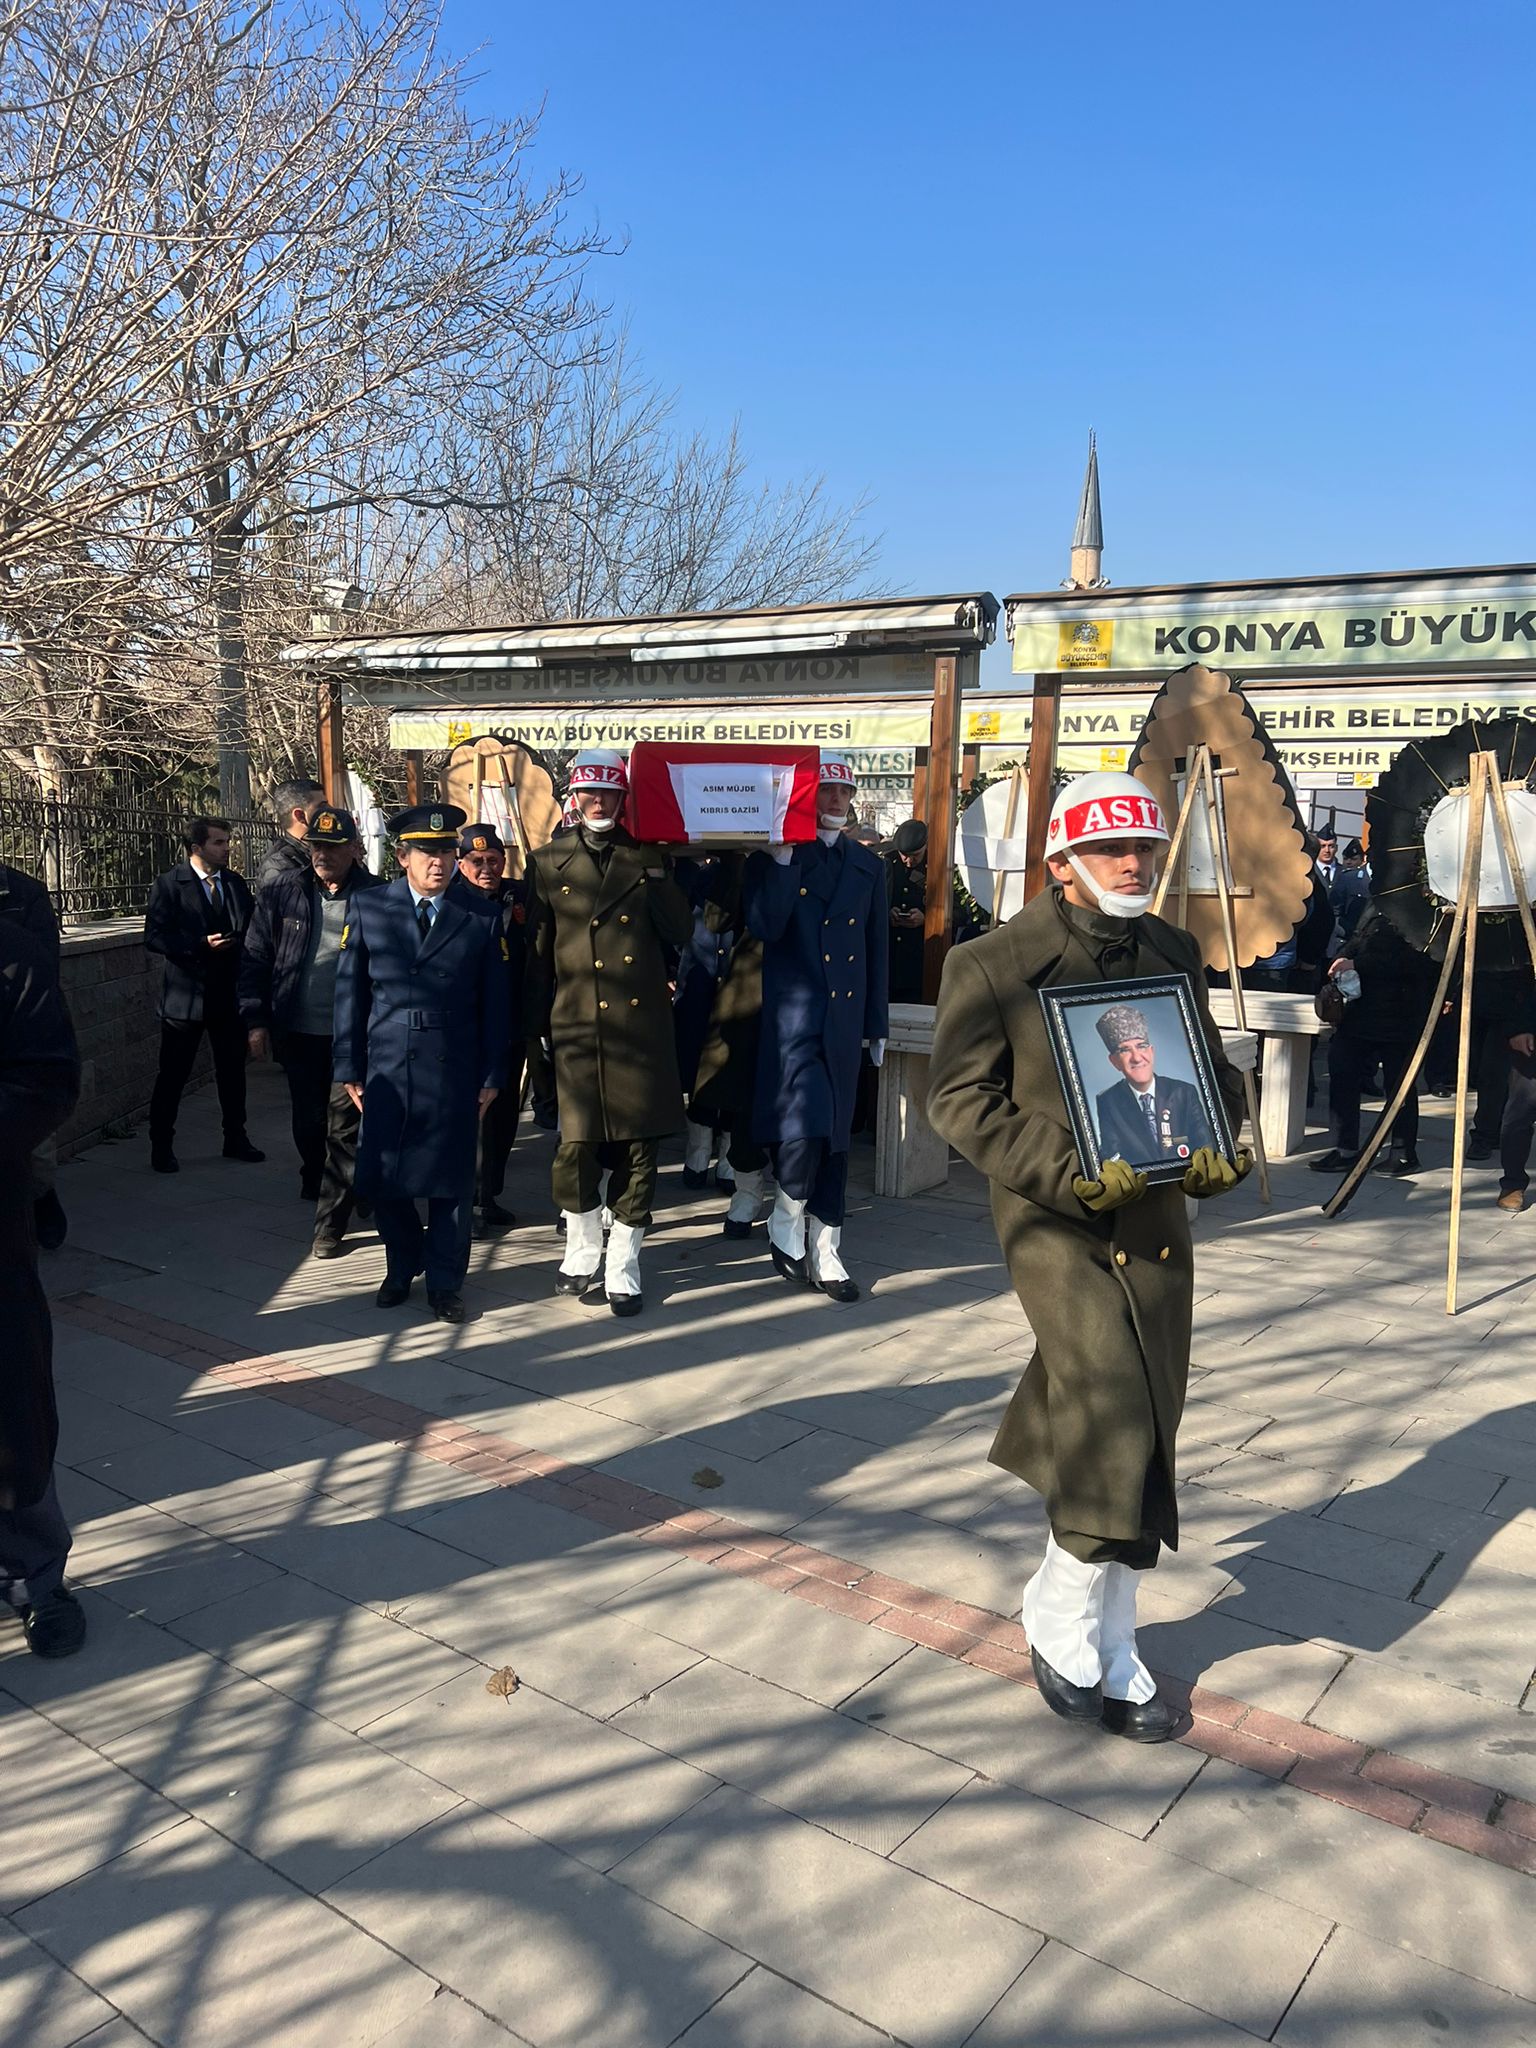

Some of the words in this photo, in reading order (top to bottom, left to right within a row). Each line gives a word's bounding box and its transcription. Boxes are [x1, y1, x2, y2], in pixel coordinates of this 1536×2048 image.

[1154, 620, 1326, 656] KONYA
[1343, 606, 1536, 649] BÜYÜK
[488, 726, 558, 742] KONYA
[564, 722, 706, 742] BÜYÜKŞEHİR
[713, 719, 851, 741] BELEDİYESİ
[1023, 714, 1120, 734] KNYA
[702, 785, 725, 793] ASIM
[725, 784, 756, 793] MÜJDE
[700, 806, 730, 814] KIBRIS
[731, 805, 760, 814] GAZİSİ
